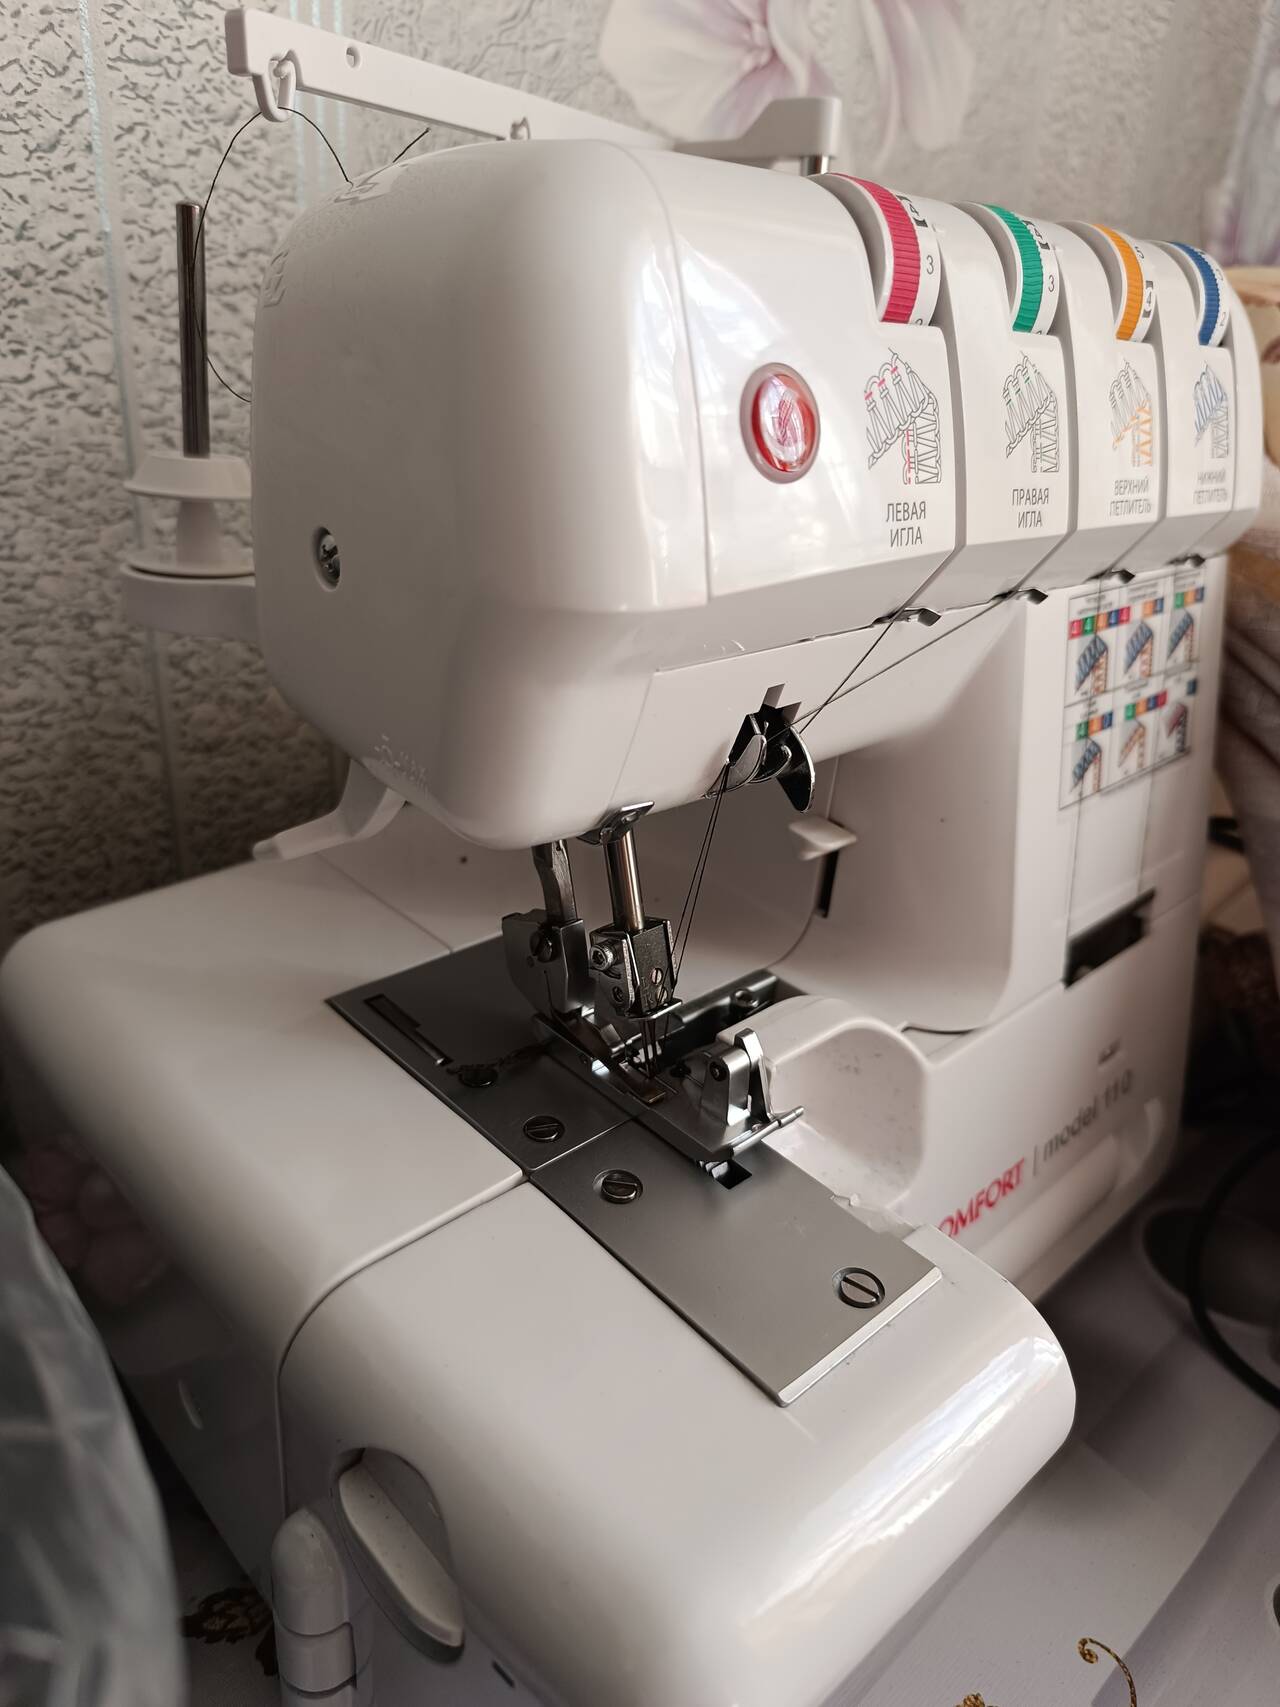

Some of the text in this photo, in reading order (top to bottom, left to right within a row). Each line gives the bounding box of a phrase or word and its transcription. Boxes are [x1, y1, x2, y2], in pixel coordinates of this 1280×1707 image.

[926, 255, 935, 275] 3
[1048, 274, 1055, 293] 3
[1114, 476, 1149, 496] ВЕРХНИЙ
[1012, 488, 1049, 506] ПРАВАЯ
[1109, 498, 1151, 516] ПЕТЛИТЕЛЬ
[886, 501, 926, 522] ЛЕВАЯ
[1018, 510, 1043, 529] ИГЛА
[890, 526, 923, 547] ИГЛА
[939, 1068, 1134, 1237] OMFORT model 110
